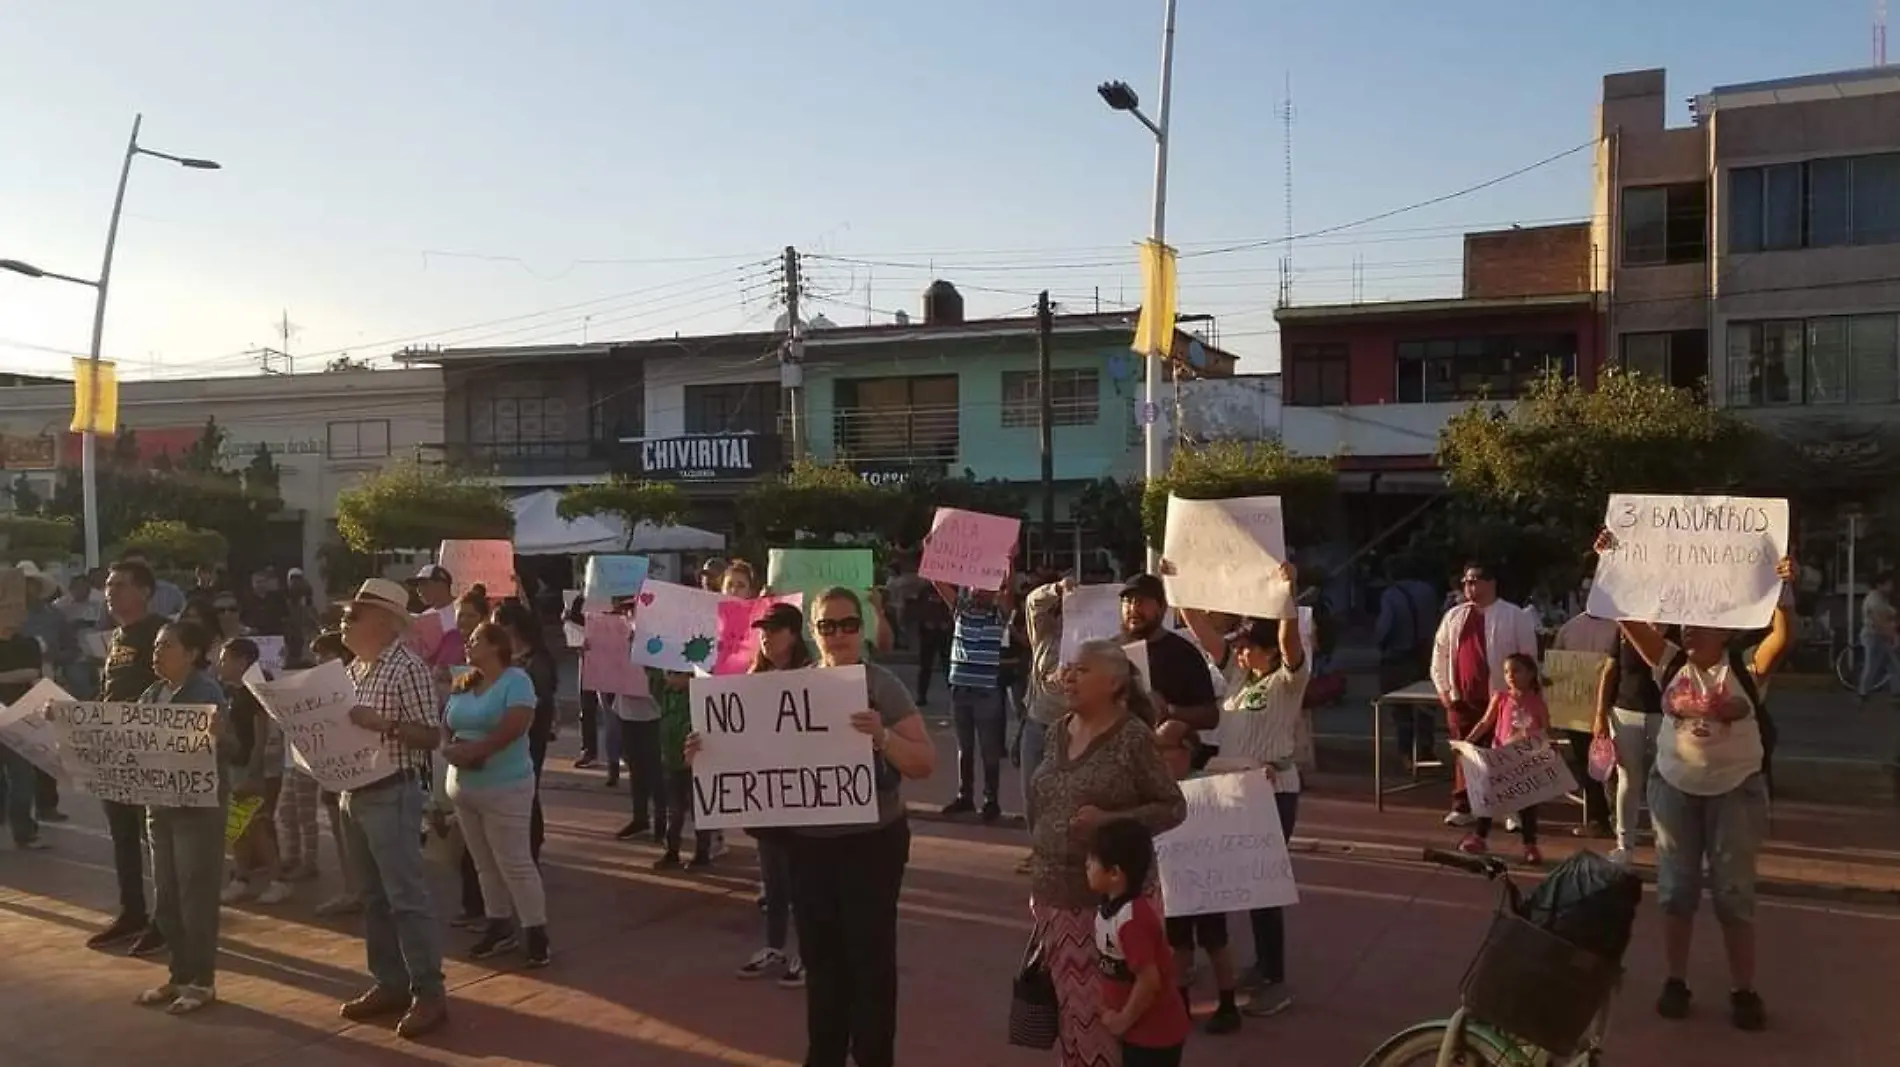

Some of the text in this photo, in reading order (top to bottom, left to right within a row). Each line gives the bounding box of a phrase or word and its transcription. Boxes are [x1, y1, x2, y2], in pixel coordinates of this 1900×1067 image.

[643, 438, 753, 472] CHIVIRITAL
[1617, 502, 1770, 533] 3 BASUREROS
[61, 704, 209, 732] NO AL BASURERO
[705, 687, 829, 735] NO AL
[163, 733, 213, 755] AGUA
[96, 766, 215, 795] ENFERMEDADES
[694, 764, 872, 816] VERTEDERO
